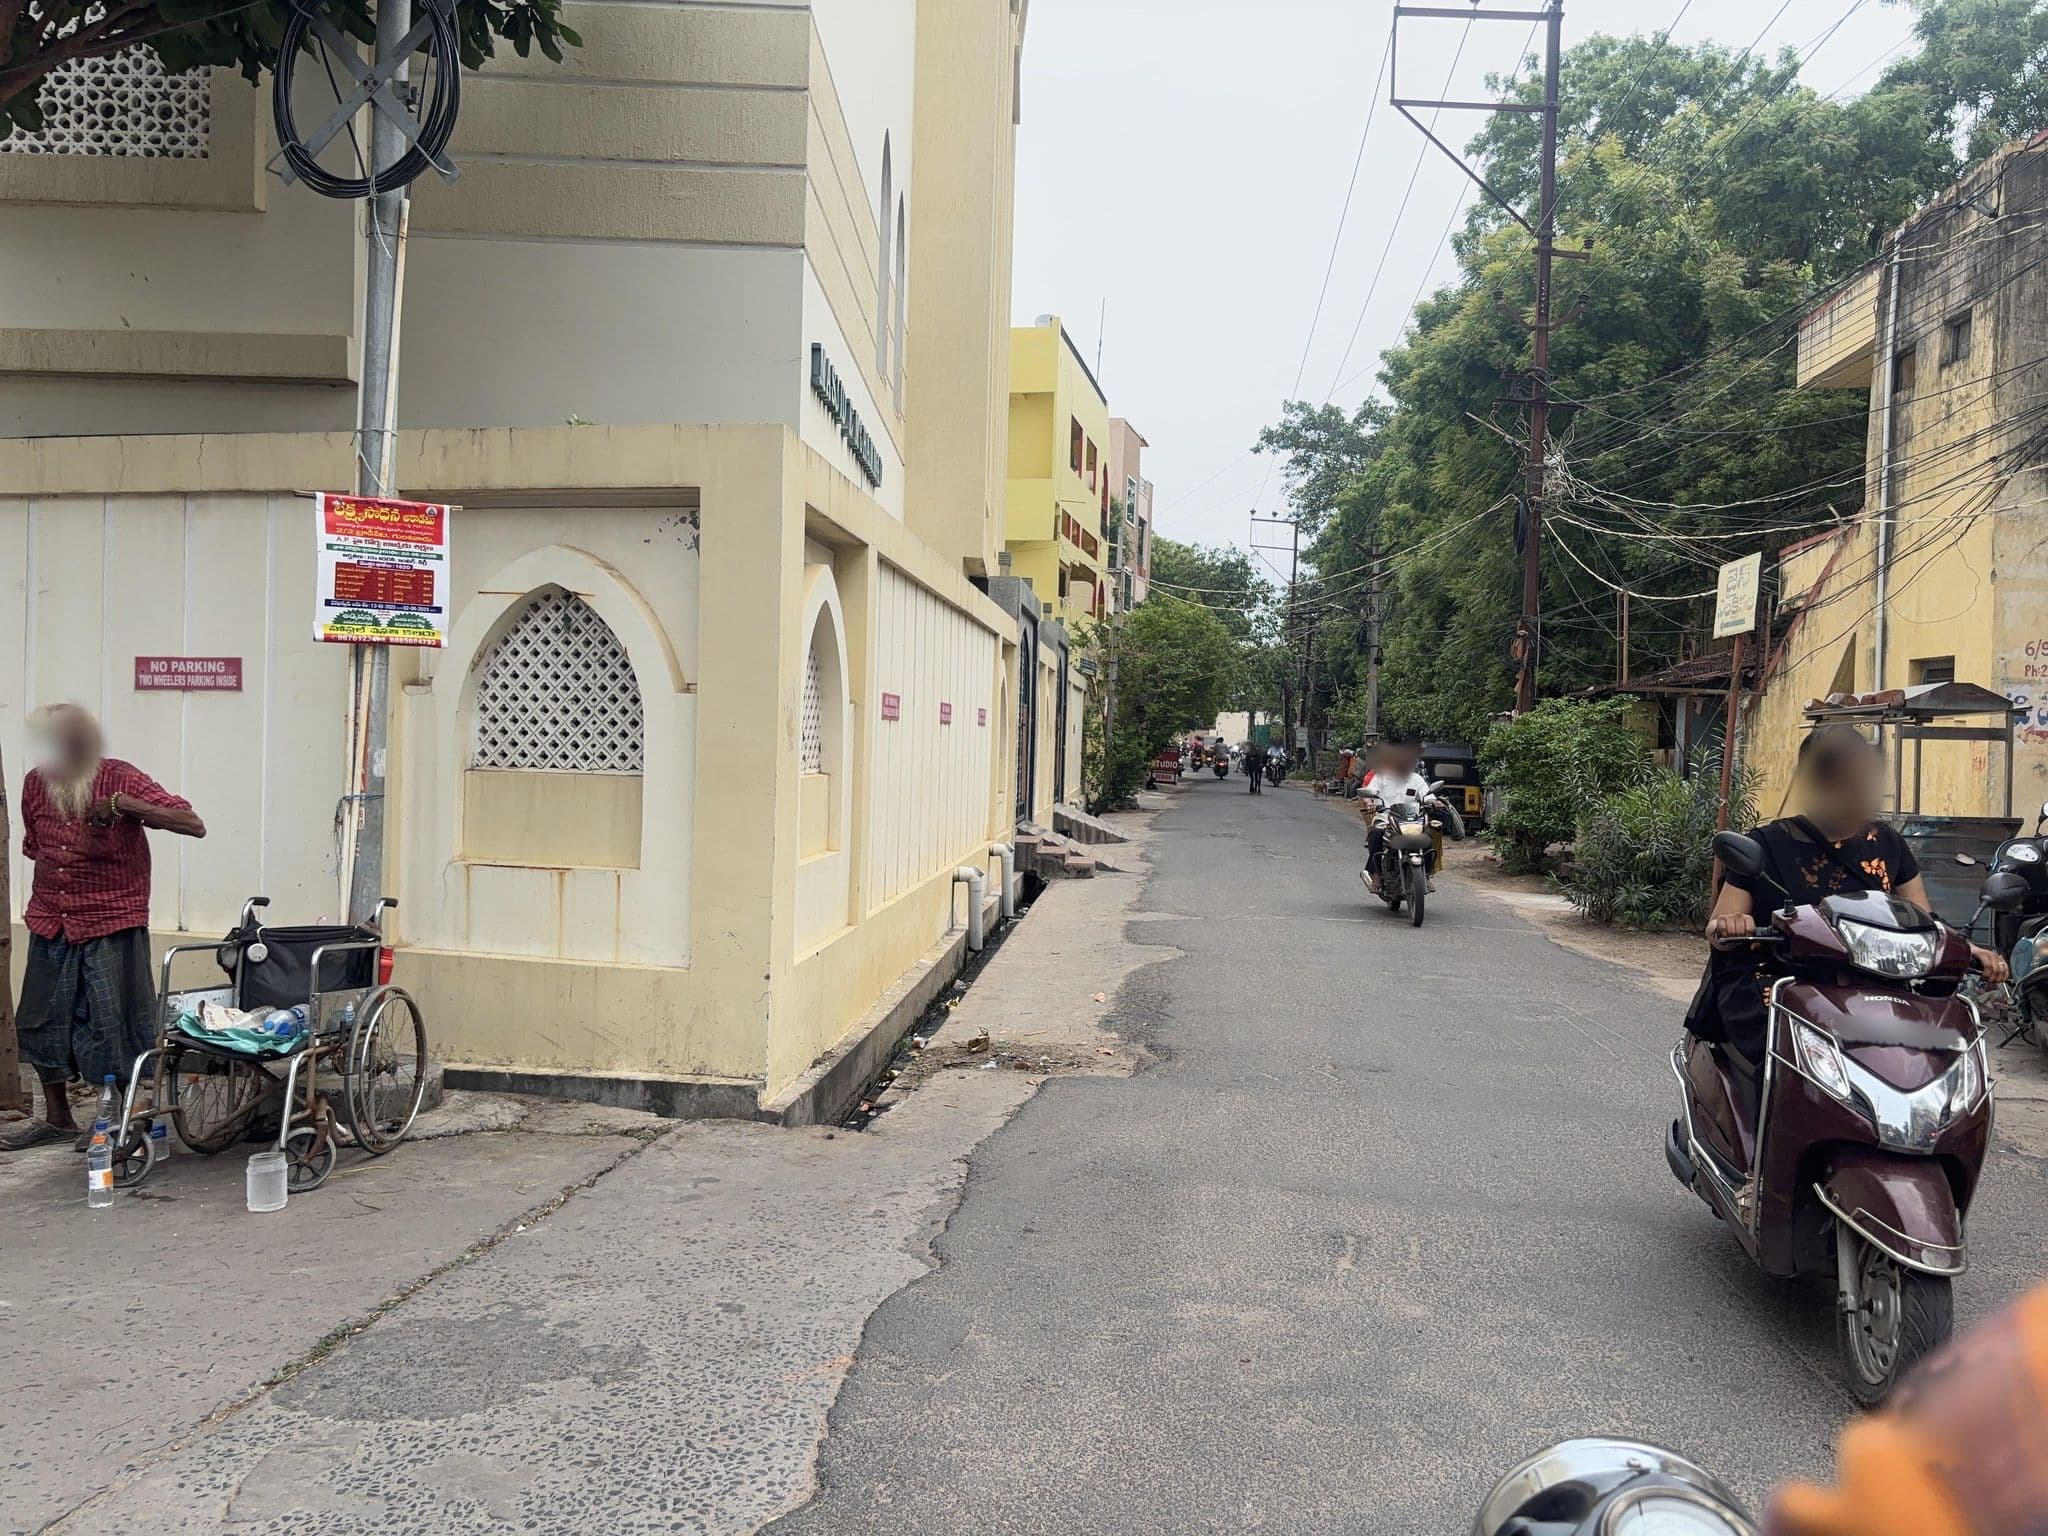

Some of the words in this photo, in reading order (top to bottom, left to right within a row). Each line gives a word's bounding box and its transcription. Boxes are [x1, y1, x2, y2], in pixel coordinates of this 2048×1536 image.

[150, 661, 168, 673] NO
[171, 661, 225, 673] PARKING
[139, 674, 153, 686] TWO
[153, 675, 186, 686] WHEELERS
[187, 675, 215, 686] PARKING
[216, 675, 237, 687] INSIDE
[1864, 995, 1910, 1005] HONDA
